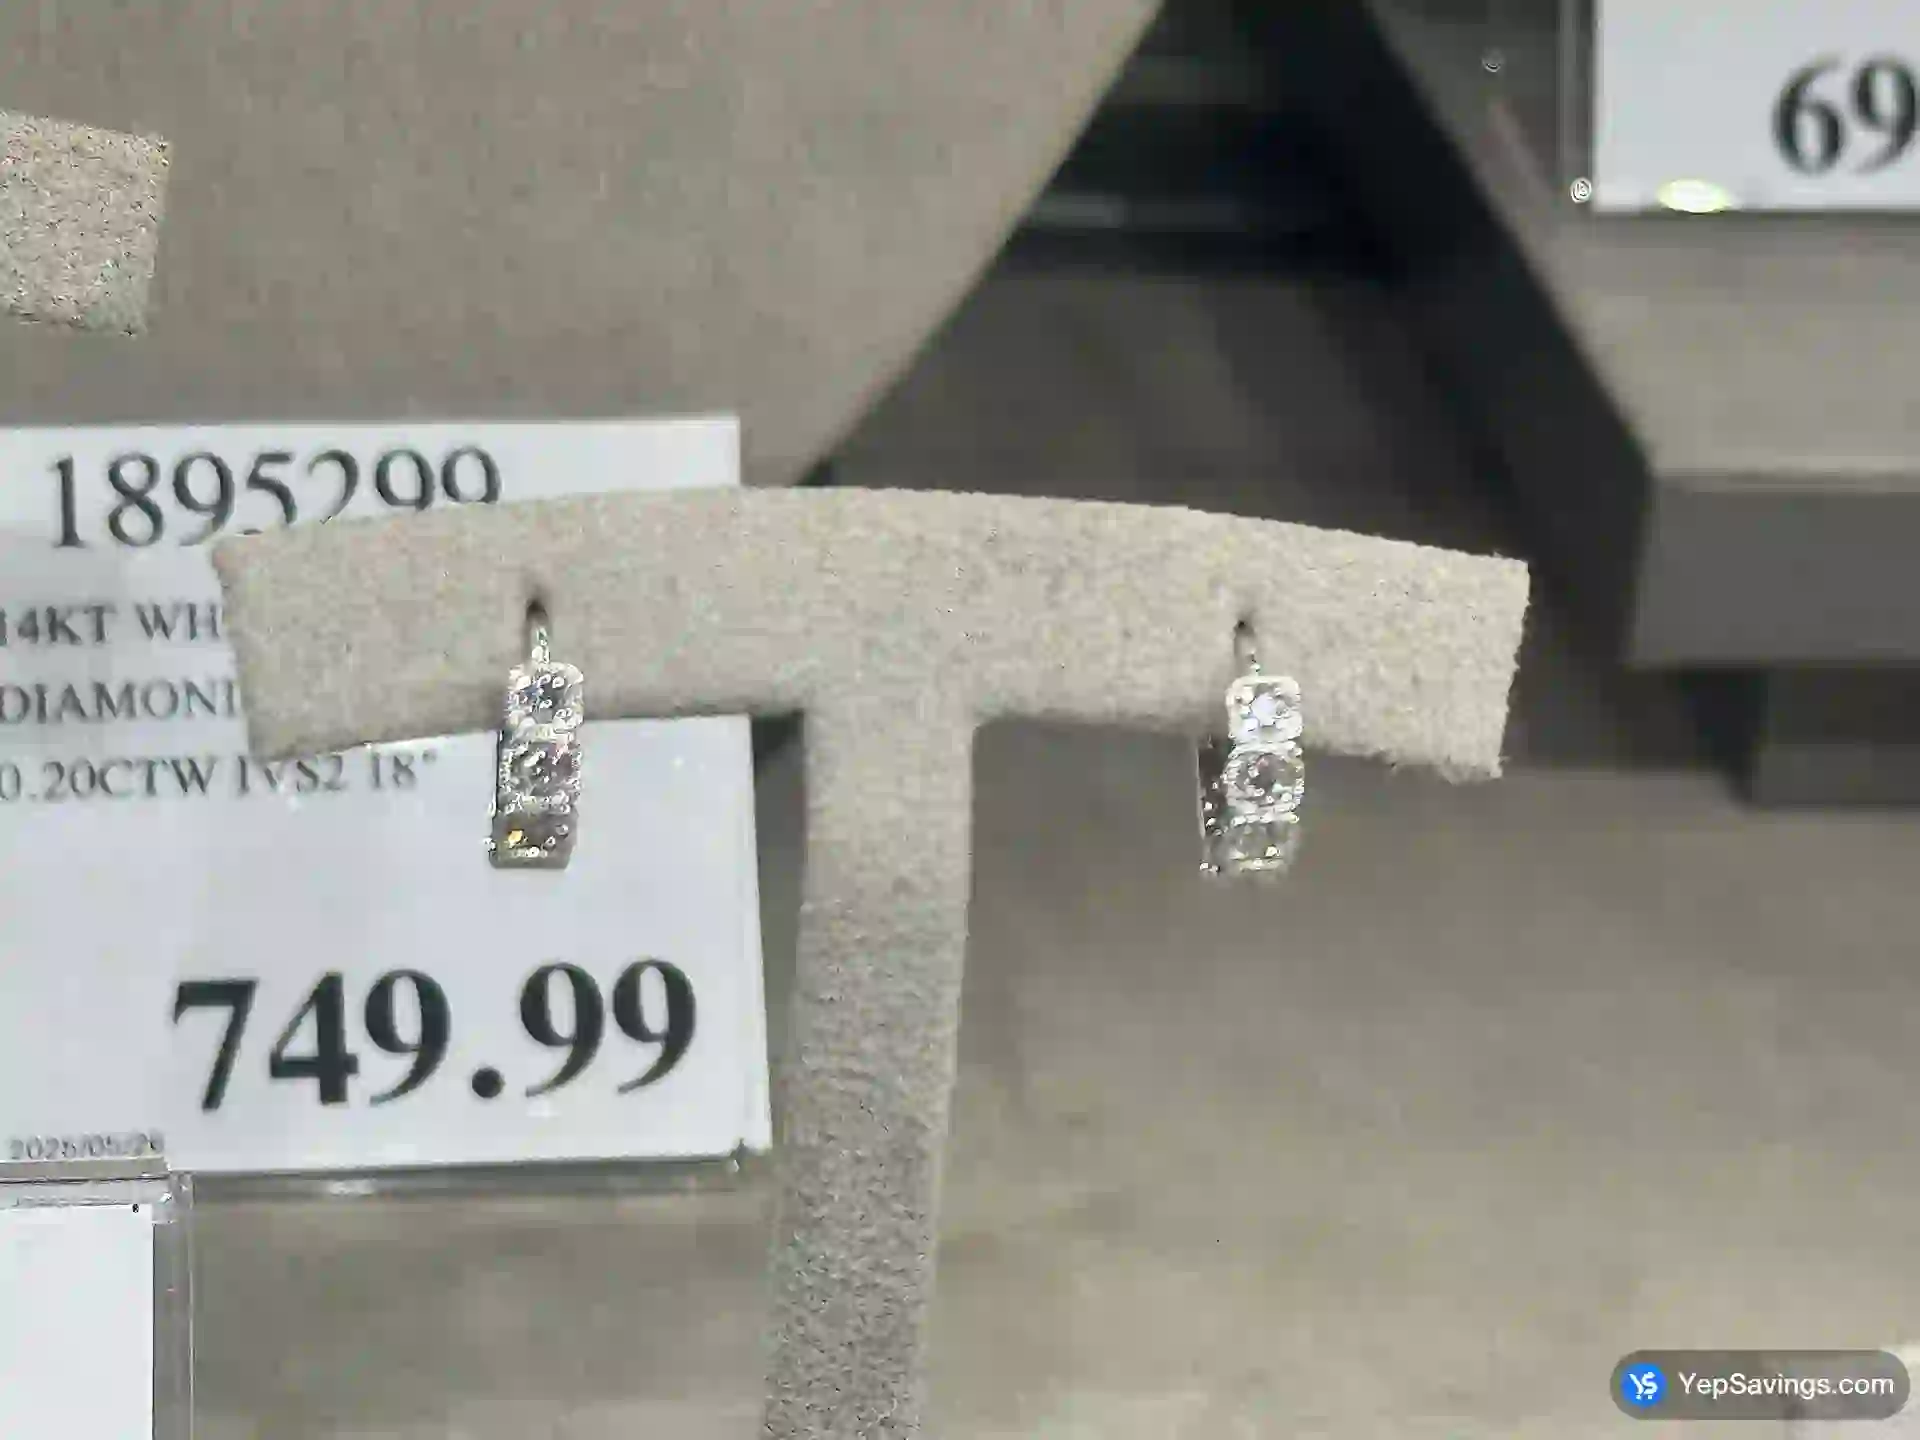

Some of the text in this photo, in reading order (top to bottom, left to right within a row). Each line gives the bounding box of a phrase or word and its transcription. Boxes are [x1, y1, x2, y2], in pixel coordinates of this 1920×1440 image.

[1772, 54, 1918, 176] 69
[50, 445, 501, 548] 1895299
[171, 958, 697, 1112] 749.99
